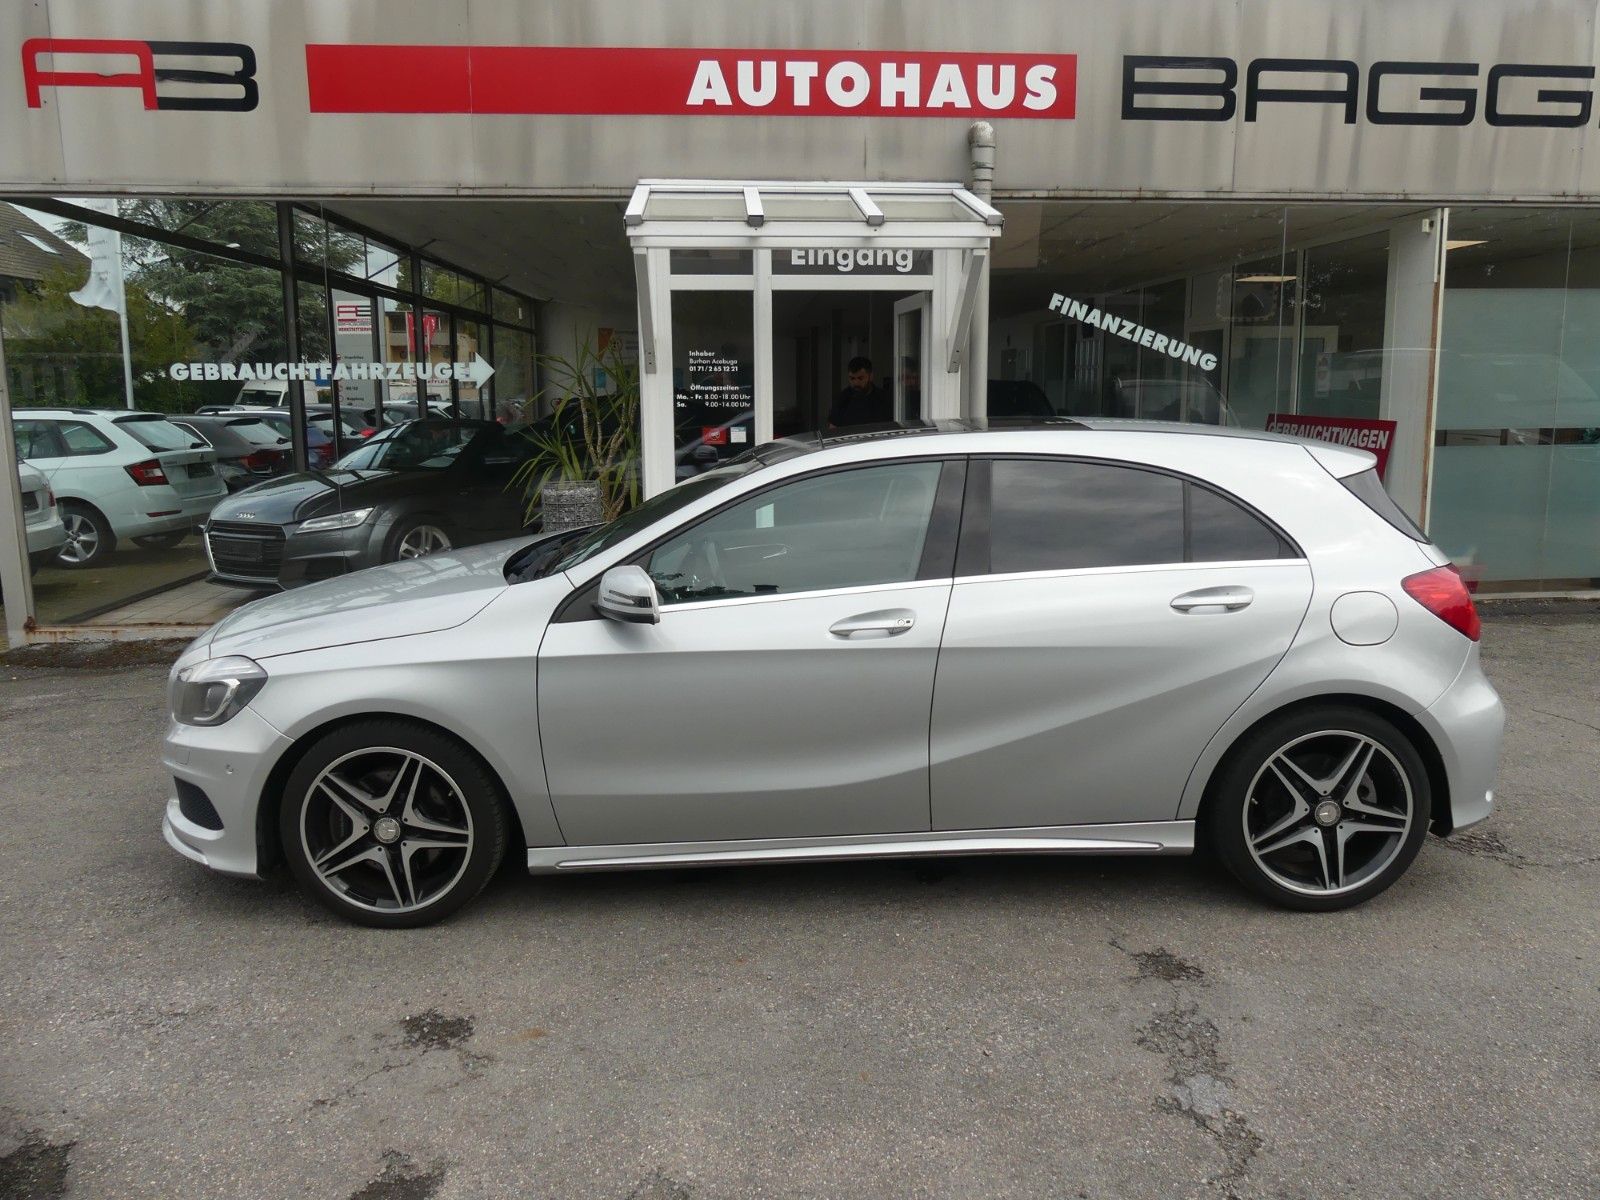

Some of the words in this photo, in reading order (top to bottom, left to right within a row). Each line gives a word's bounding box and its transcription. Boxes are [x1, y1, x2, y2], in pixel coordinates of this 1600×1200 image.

[22, 38, 259, 112] AB
[686, 59, 1058, 111] AUTOHAUS
[1121, 54, 1600, 128] BAGG
[791, 249, 914, 273] Eingang
[1048, 293, 1218, 371] FINANZIERUNG
[169, 361, 469, 381] GEBRAUCHTFAHRZEUGE
[690, 383, 740, 392] Öffnungszeiten
